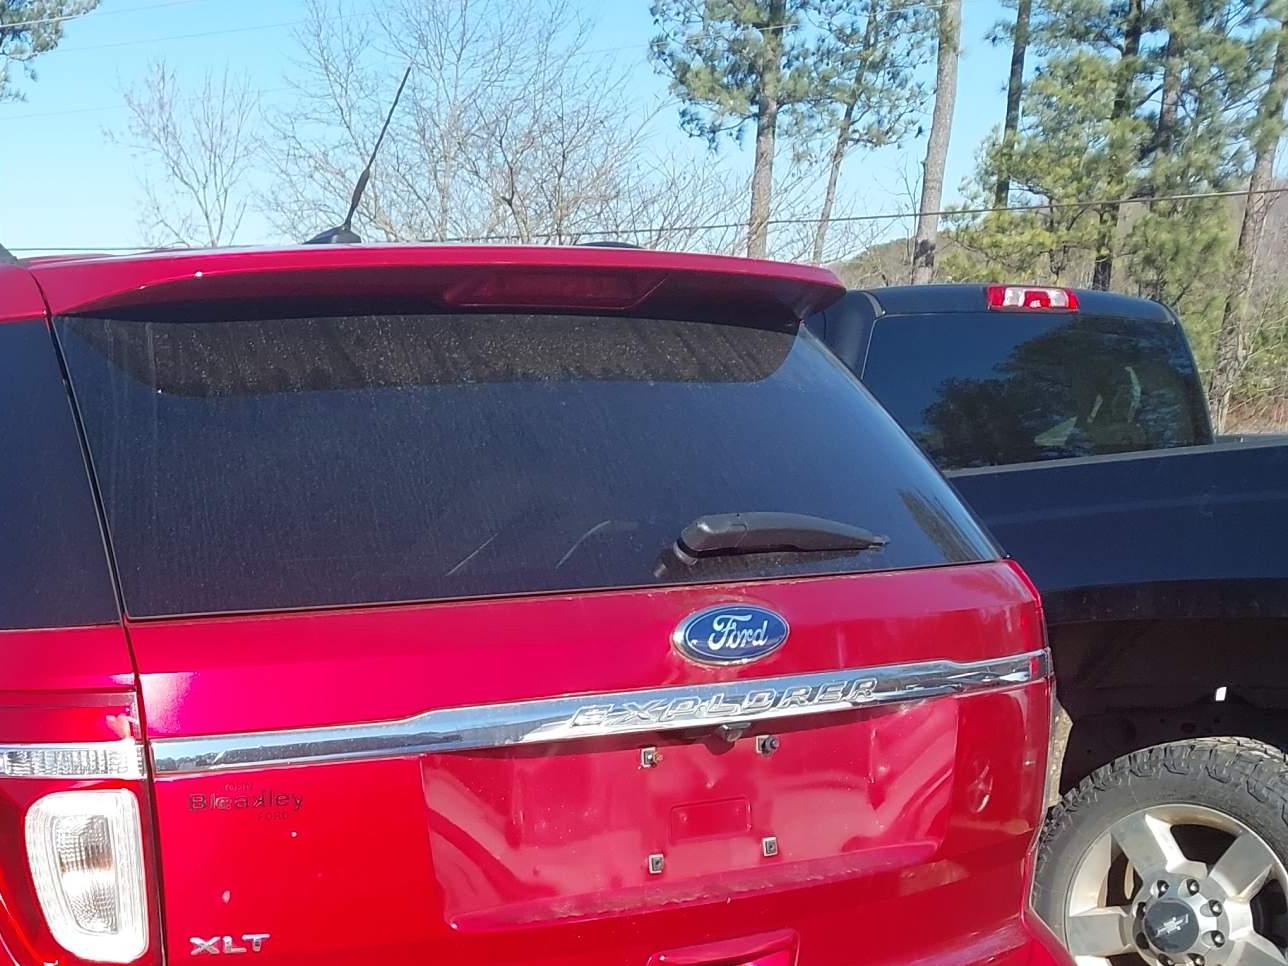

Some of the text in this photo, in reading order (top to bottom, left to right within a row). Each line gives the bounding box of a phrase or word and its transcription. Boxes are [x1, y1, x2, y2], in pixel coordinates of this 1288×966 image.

[708, 613, 769, 651] Ford
[569, 677, 879, 728] EXPLORER
[189, 933, 271, 956] XLT
